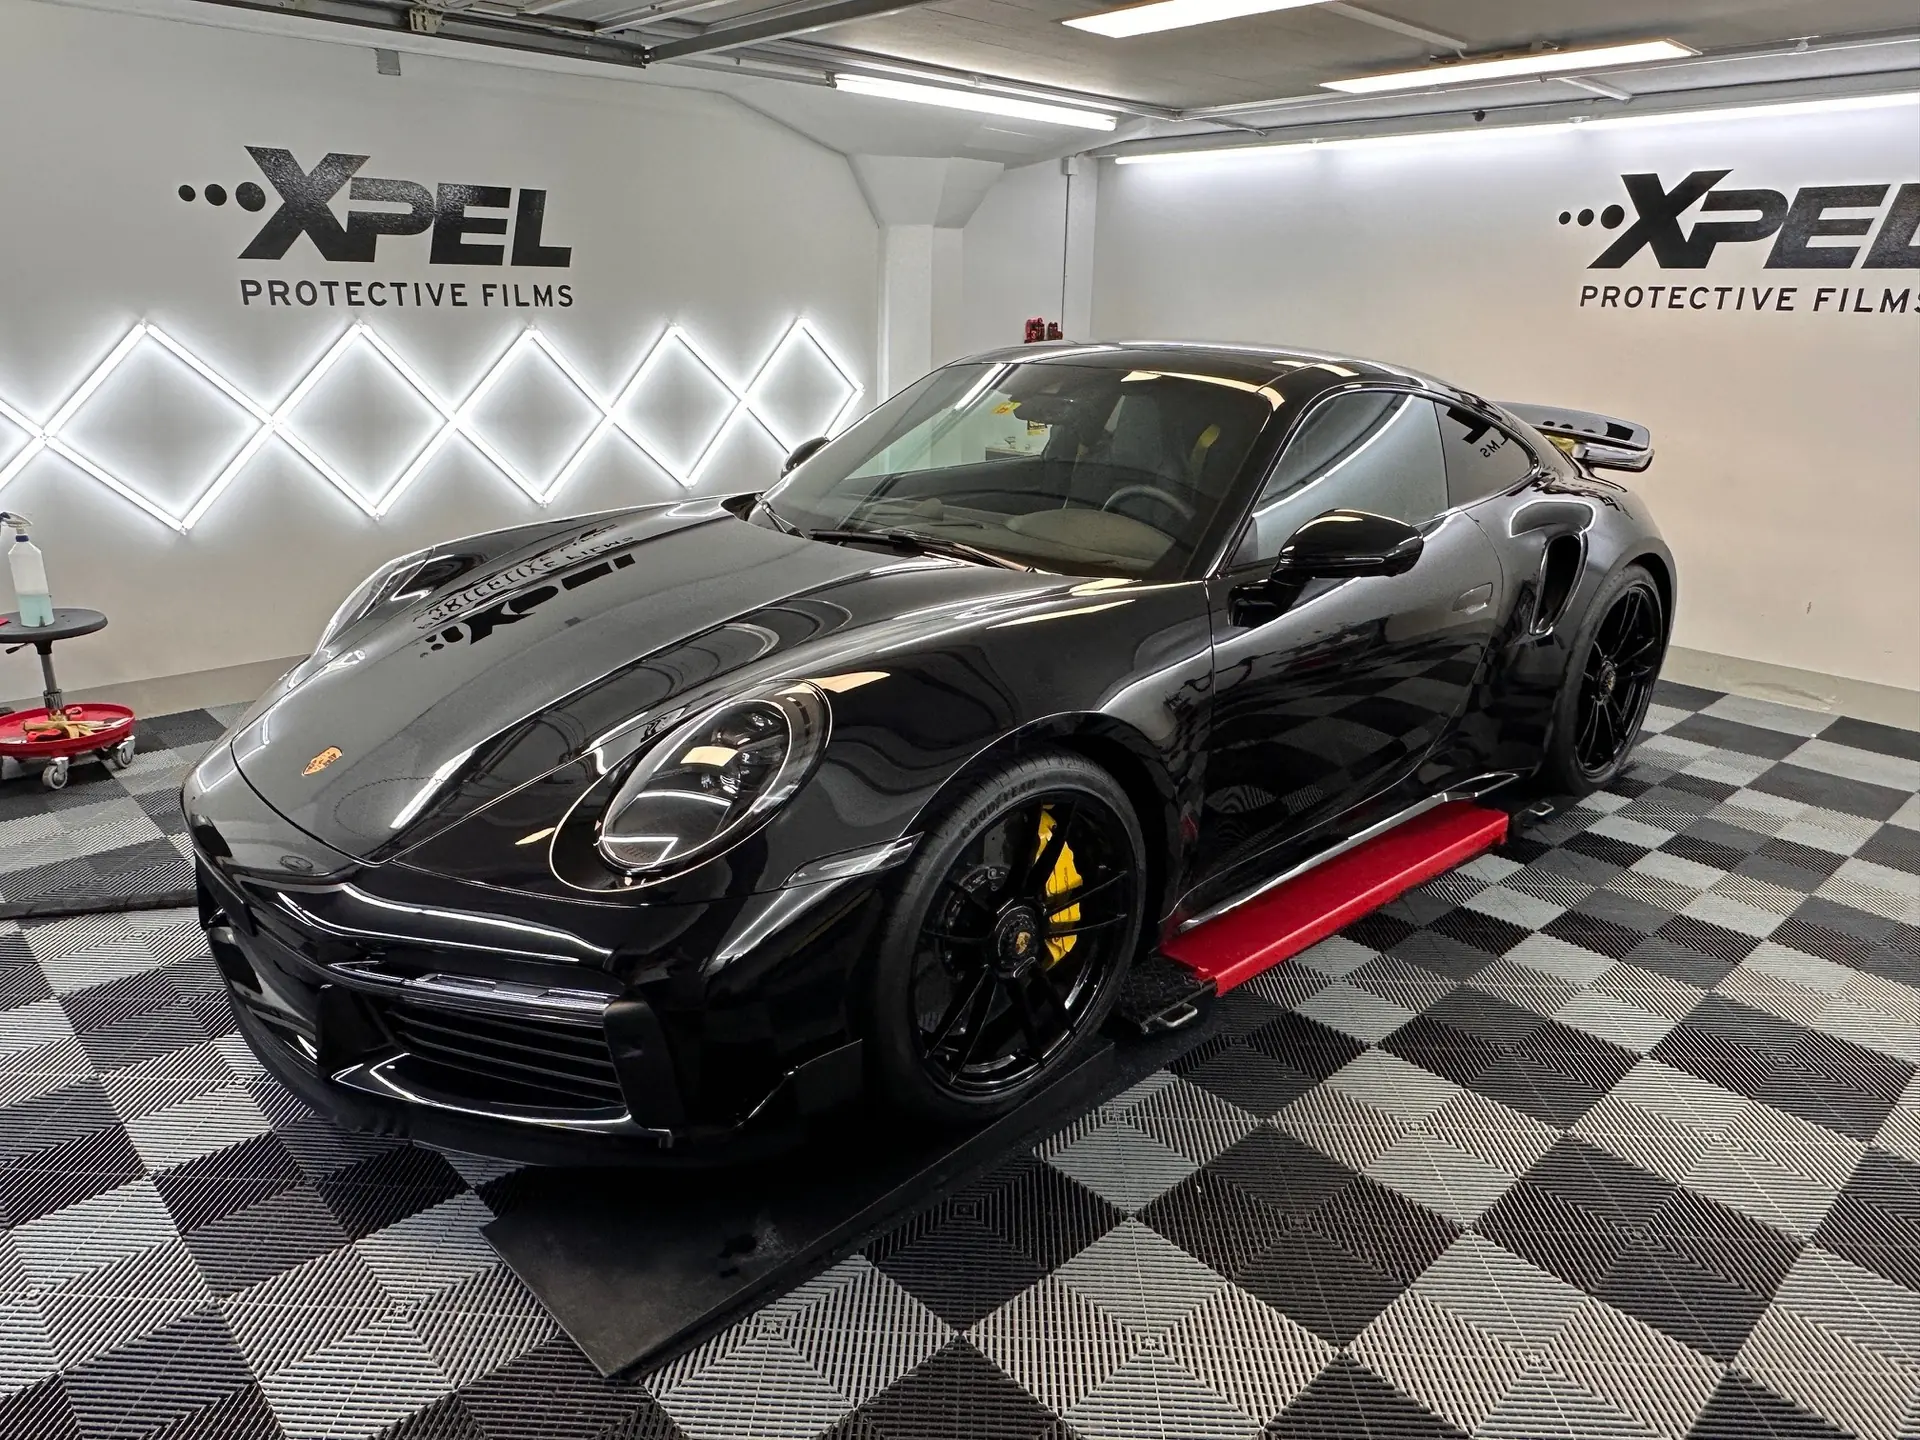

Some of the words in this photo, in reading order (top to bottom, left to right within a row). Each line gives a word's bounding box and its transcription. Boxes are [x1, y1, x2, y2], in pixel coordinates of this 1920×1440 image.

[237, 145, 572, 268] XPEL
[1586, 168, 1920, 269] XPEL
[240, 279, 468, 306] PROTECTIVE
[482, 283, 574, 308] FILMS
[1579, 285, 1798, 311] PROTECTIVE
[959, 778, 1037, 839] GOODYEAR
